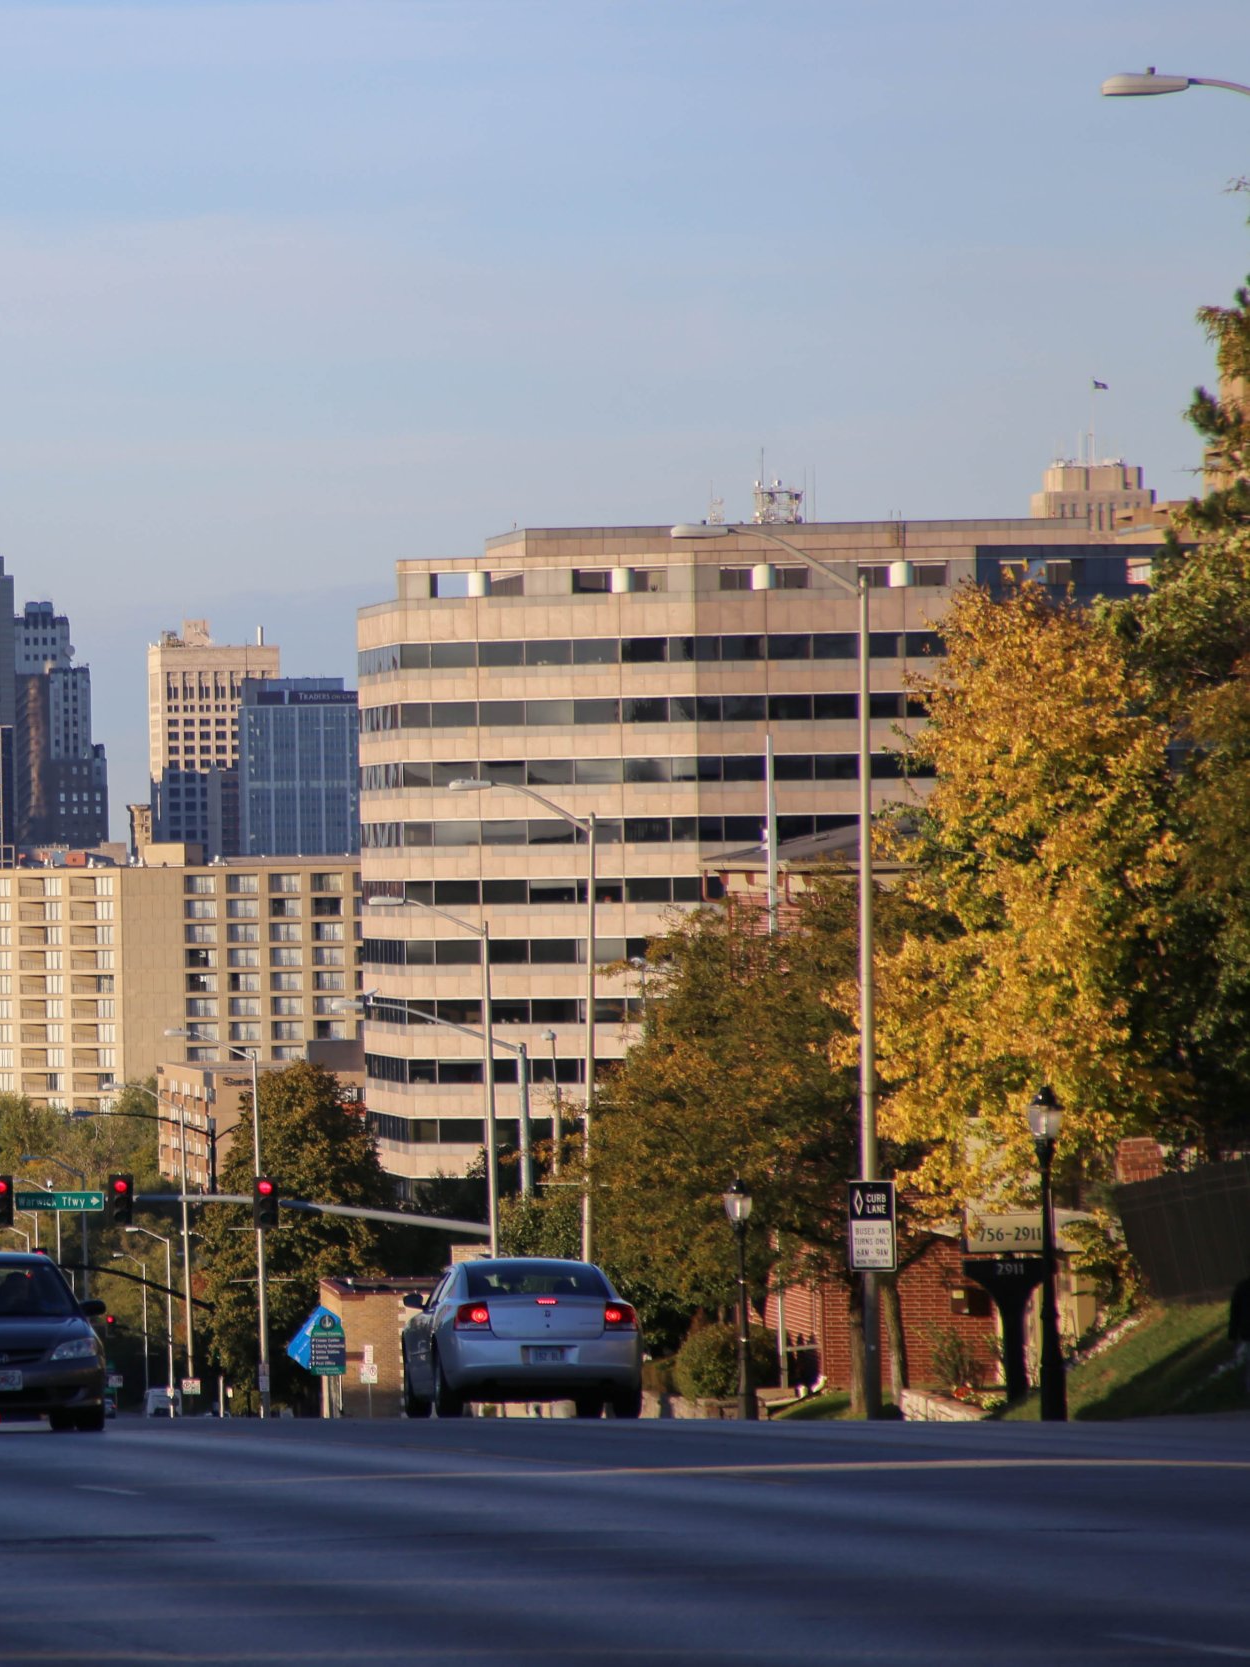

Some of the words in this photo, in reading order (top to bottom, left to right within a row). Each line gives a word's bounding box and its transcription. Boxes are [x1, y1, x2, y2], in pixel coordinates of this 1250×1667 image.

[62, 1196, 85, 1208] Tfwy
[865, 1193, 887, 1203] CURB
[866, 1204, 887, 1214] LANE
[855, 1227, 875, 1235] BUSES
[878, 1227, 890, 1235] AND
[979, 1226, 1042, 1242] 756-2911
[997, 1263, 1024, 1275] 2911
